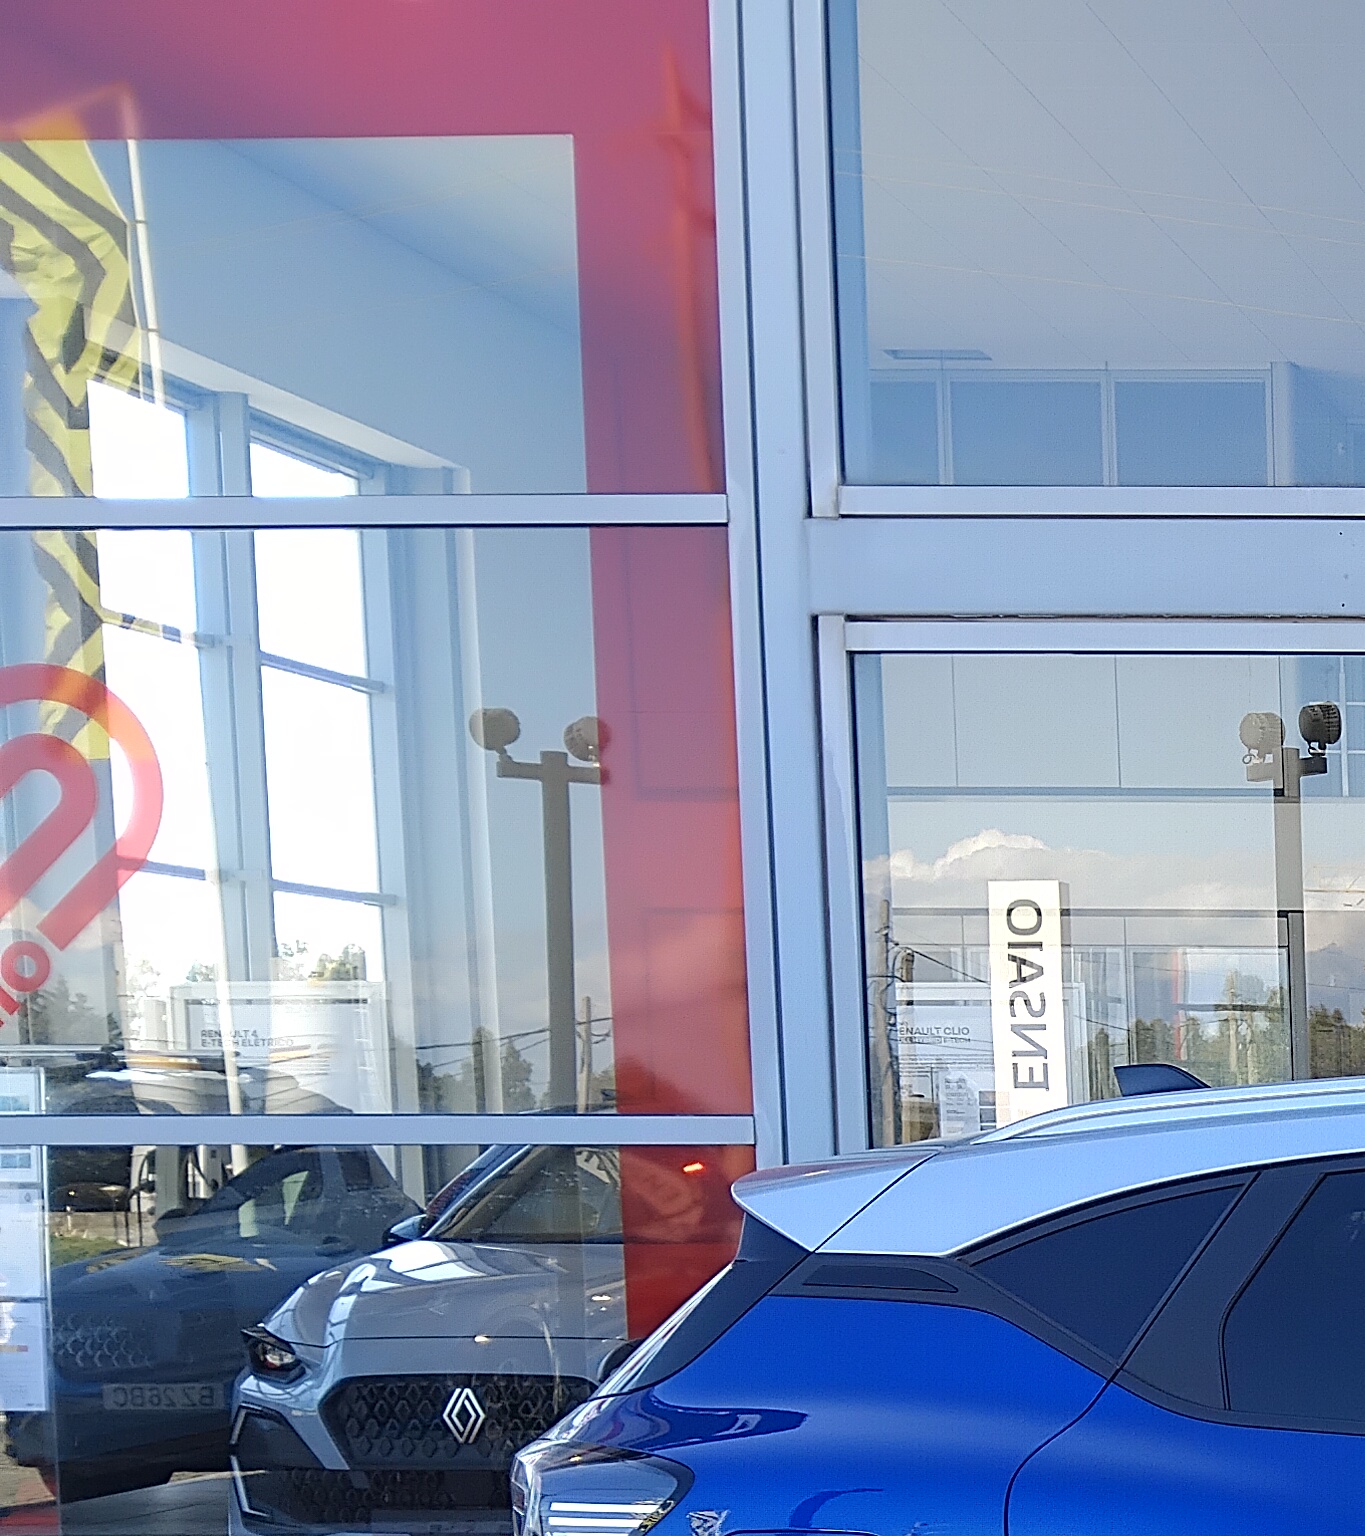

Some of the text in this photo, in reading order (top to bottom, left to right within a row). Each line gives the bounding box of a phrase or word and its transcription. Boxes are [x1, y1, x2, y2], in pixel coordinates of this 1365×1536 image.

[201, 1029, 250, 1038] RENULT
[899, 1026, 970, 1036] ENAULT CLIO
[201, 1039, 240, 1047] E-TEH
